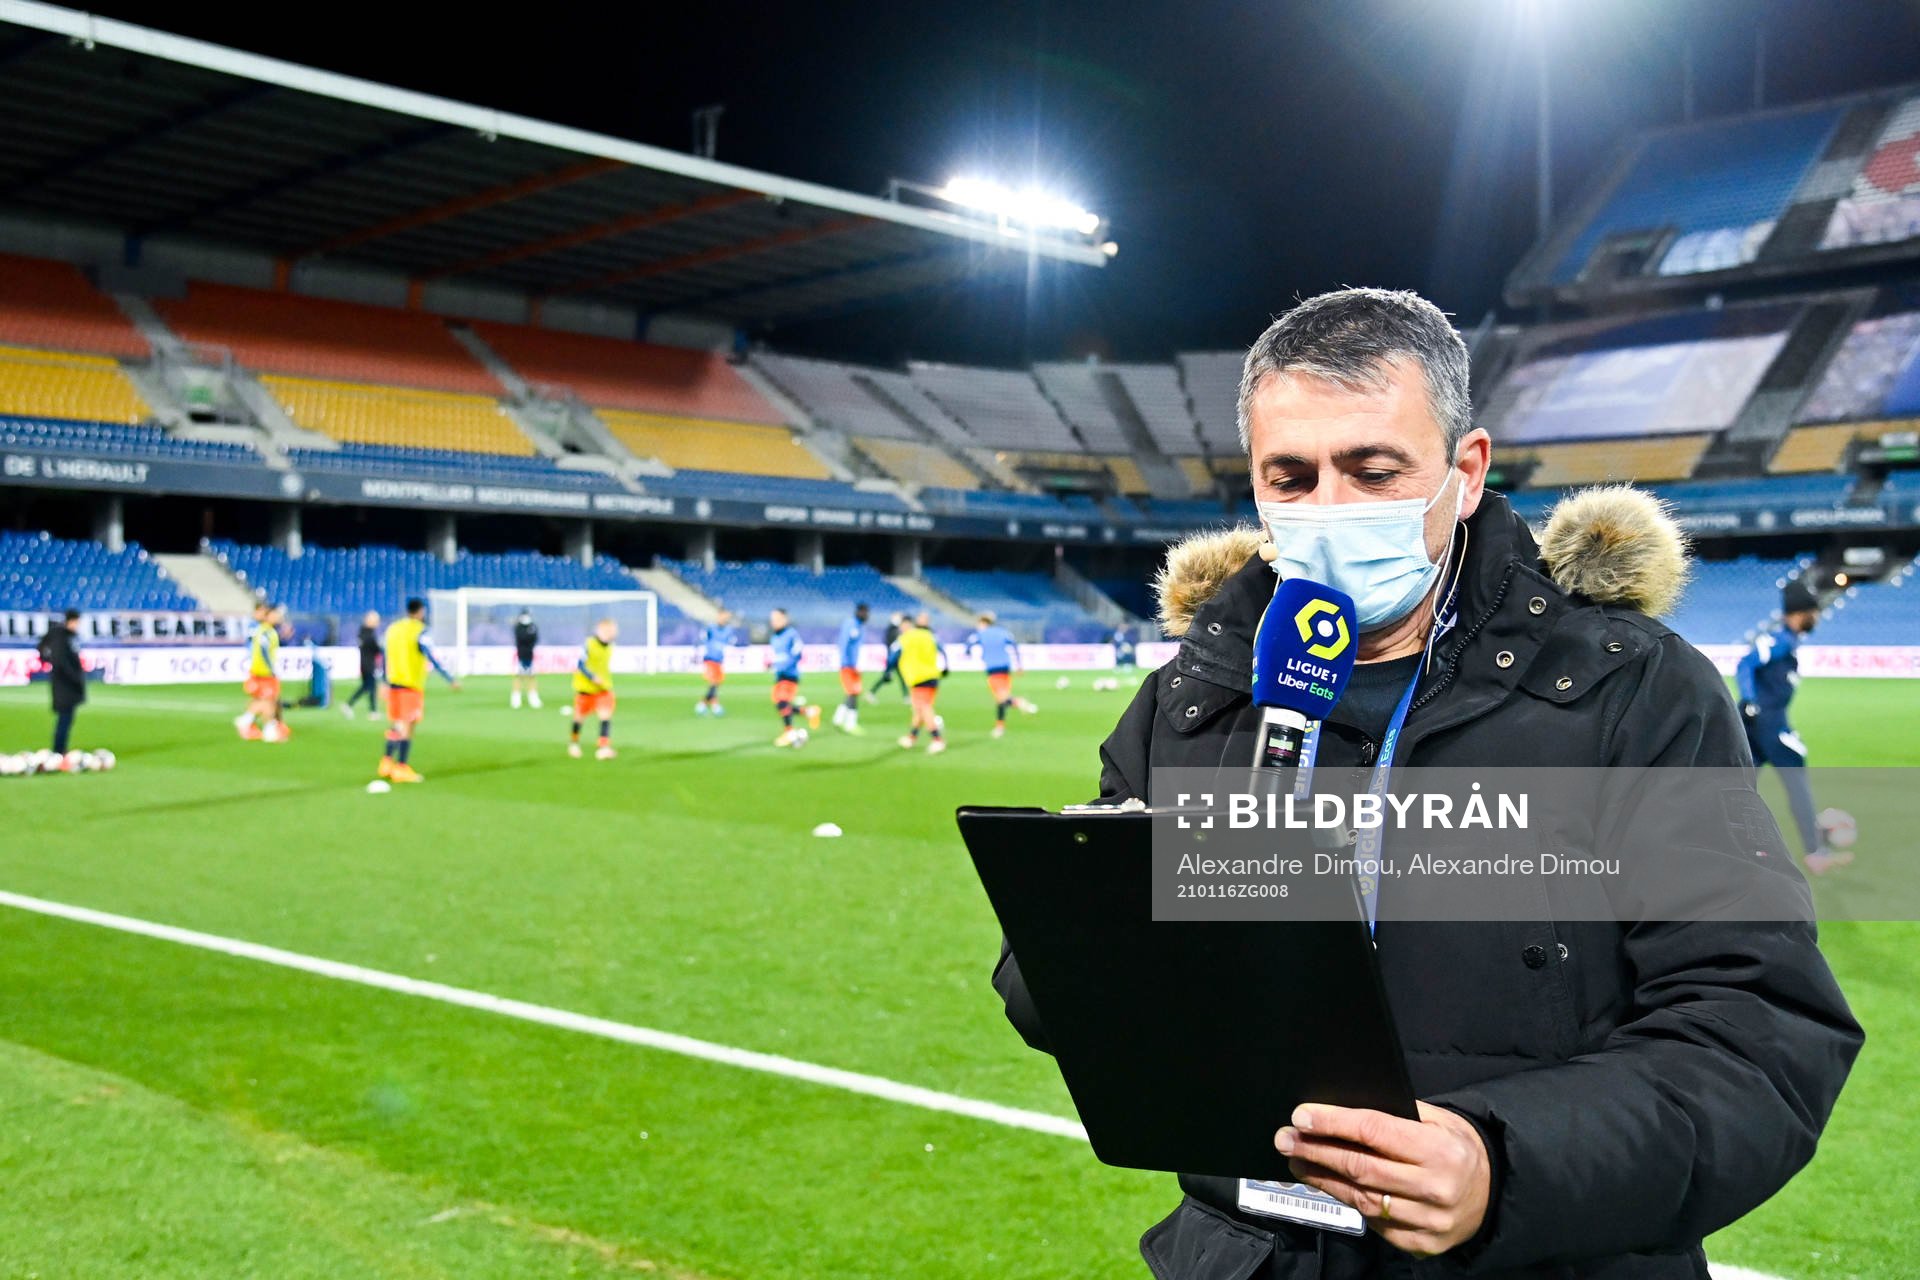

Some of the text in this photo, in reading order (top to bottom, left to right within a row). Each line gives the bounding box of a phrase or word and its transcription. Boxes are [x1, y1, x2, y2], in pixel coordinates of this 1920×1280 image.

[1286, 658, 1338, 684] LIGUE 1
[1277, 672, 1335, 701] Uber Eats
